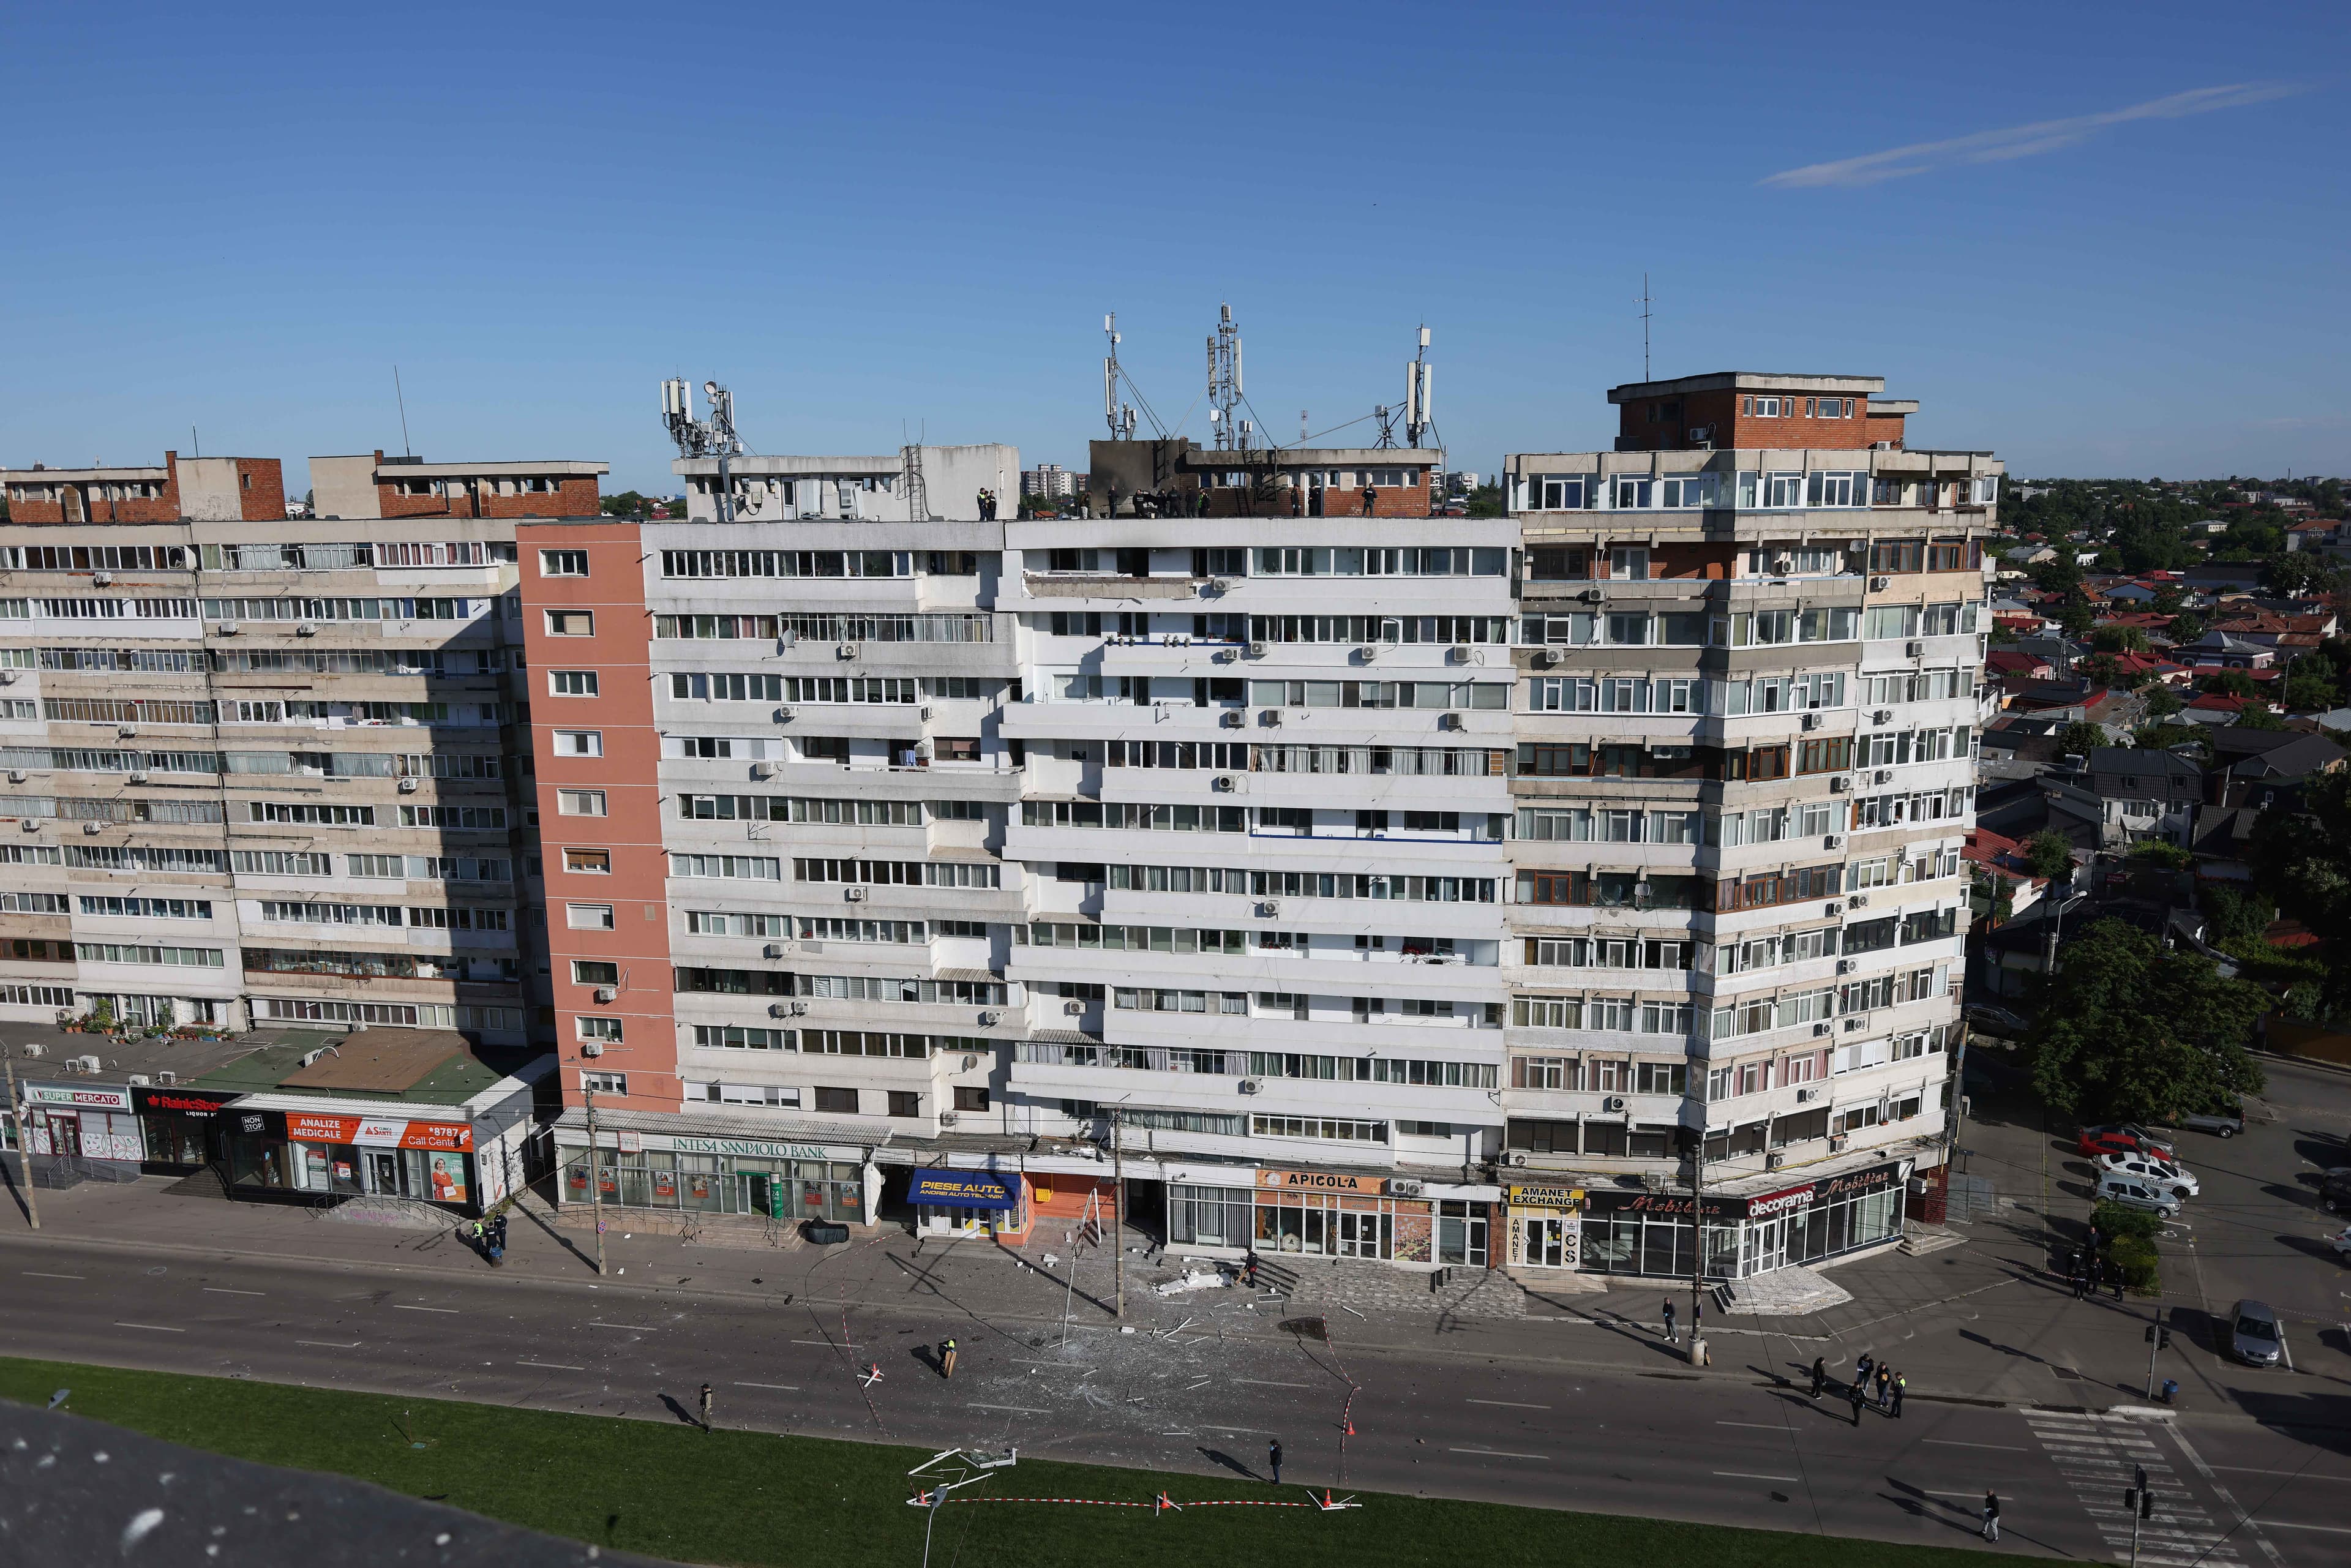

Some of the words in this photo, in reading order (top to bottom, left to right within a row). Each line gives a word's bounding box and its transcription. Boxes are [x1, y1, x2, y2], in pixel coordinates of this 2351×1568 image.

[43, 1092, 73, 1101] SUPER
[75, 1093, 119, 1105] MERCATO
[161, 1097, 223, 1111] RainicStor
[300, 1118, 340, 1128] ANALIZE
[293, 1128, 342, 1139] MEDICALE
[373, 1126, 392, 1136] SANTE
[408, 1136, 426, 1146] Call
[429, 1137, 460, 1147] Center
[673, 1138, 717, 1152] INTESA
[721, 1141, 787, 1157] SANPAOLO
[791, 1146, 828, 1159] BANK
[920, 1180, 962, 1191] PIESE
[963, 1184, 1005, 1195] AUTO
[1288, 1174, 1359, 1189] APICOLA
[1521, 1187, 1573, 1198] AMANET
[1513, 1195, 1580, 1206] EXCHANGE
[1749, 1190, 1814, 1217] decorama
